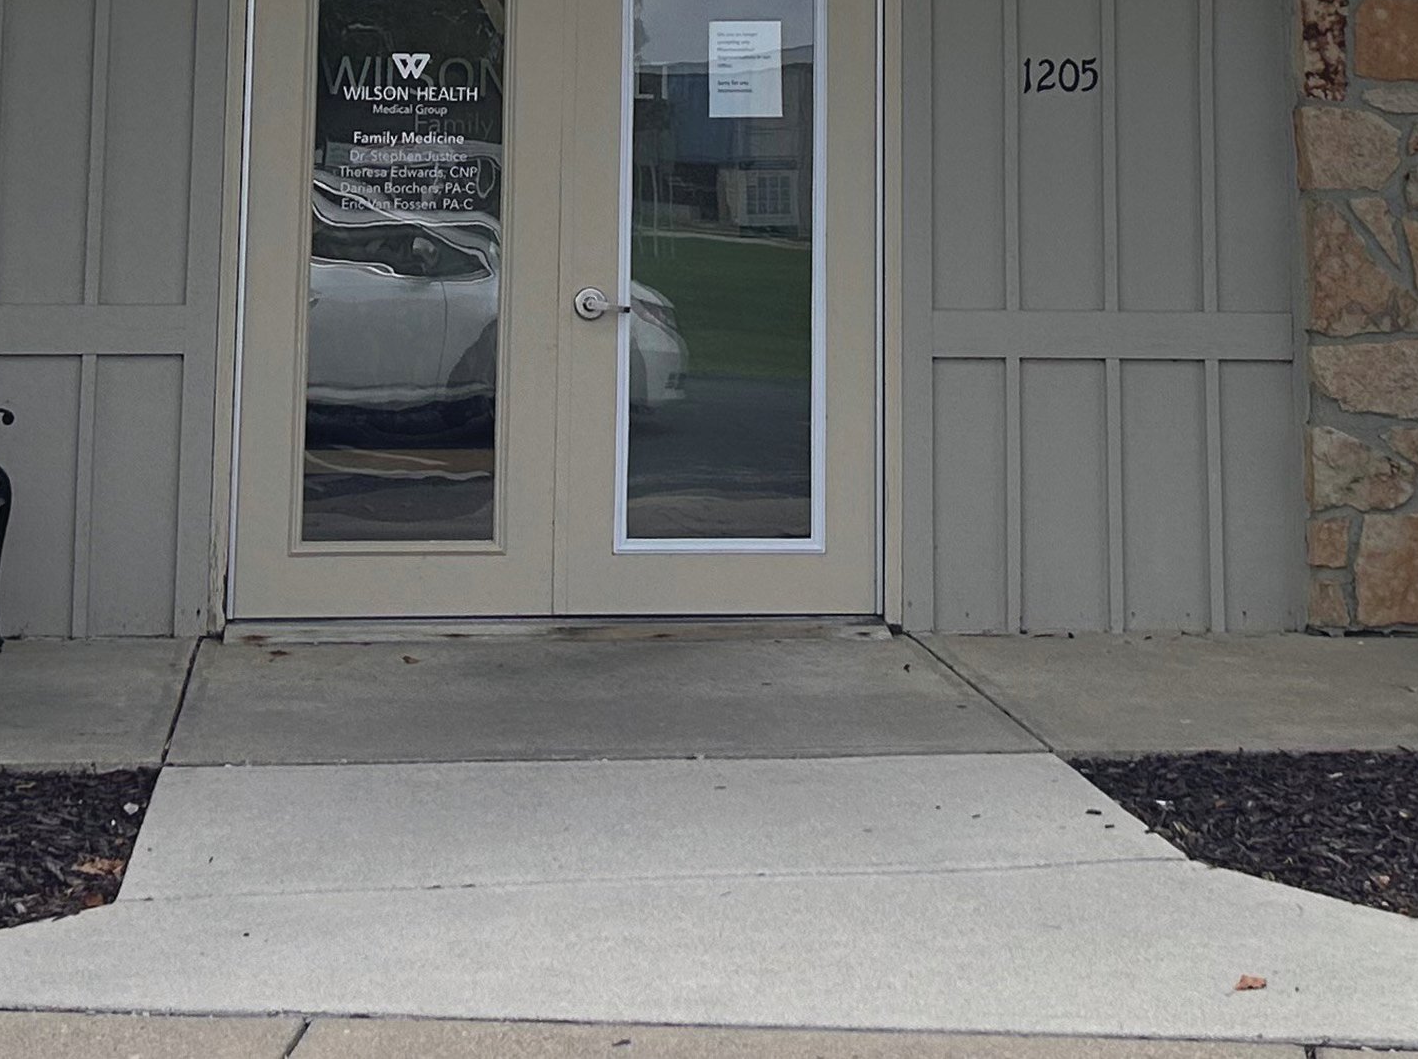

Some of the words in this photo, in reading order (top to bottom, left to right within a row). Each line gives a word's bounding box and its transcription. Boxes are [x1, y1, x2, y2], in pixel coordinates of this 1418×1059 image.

[1023, 57, 1098, 94] 1205
[343, 86, 408, 101] WILSON
[417, 87, 478, 102] HEALTH
[372, 104, 412, 114] Medical
[415, 104, 448, 117] Group
[353, 131, 398, 147] Family
[402, 131, 465, 144] Medicine
[371, 150, 422, 164] Stephen
[425, 150, 468, 162] Justice
[339, 166, 387, 178] Theresa
[391, 166, 447, 179] Edwards,
[449, 167, 478, 178] CNP
[384, 182, 442, 195] Borchers,
[445, 183, 477, 194] PA-C
[442, 199, 474, 210] PA-C
